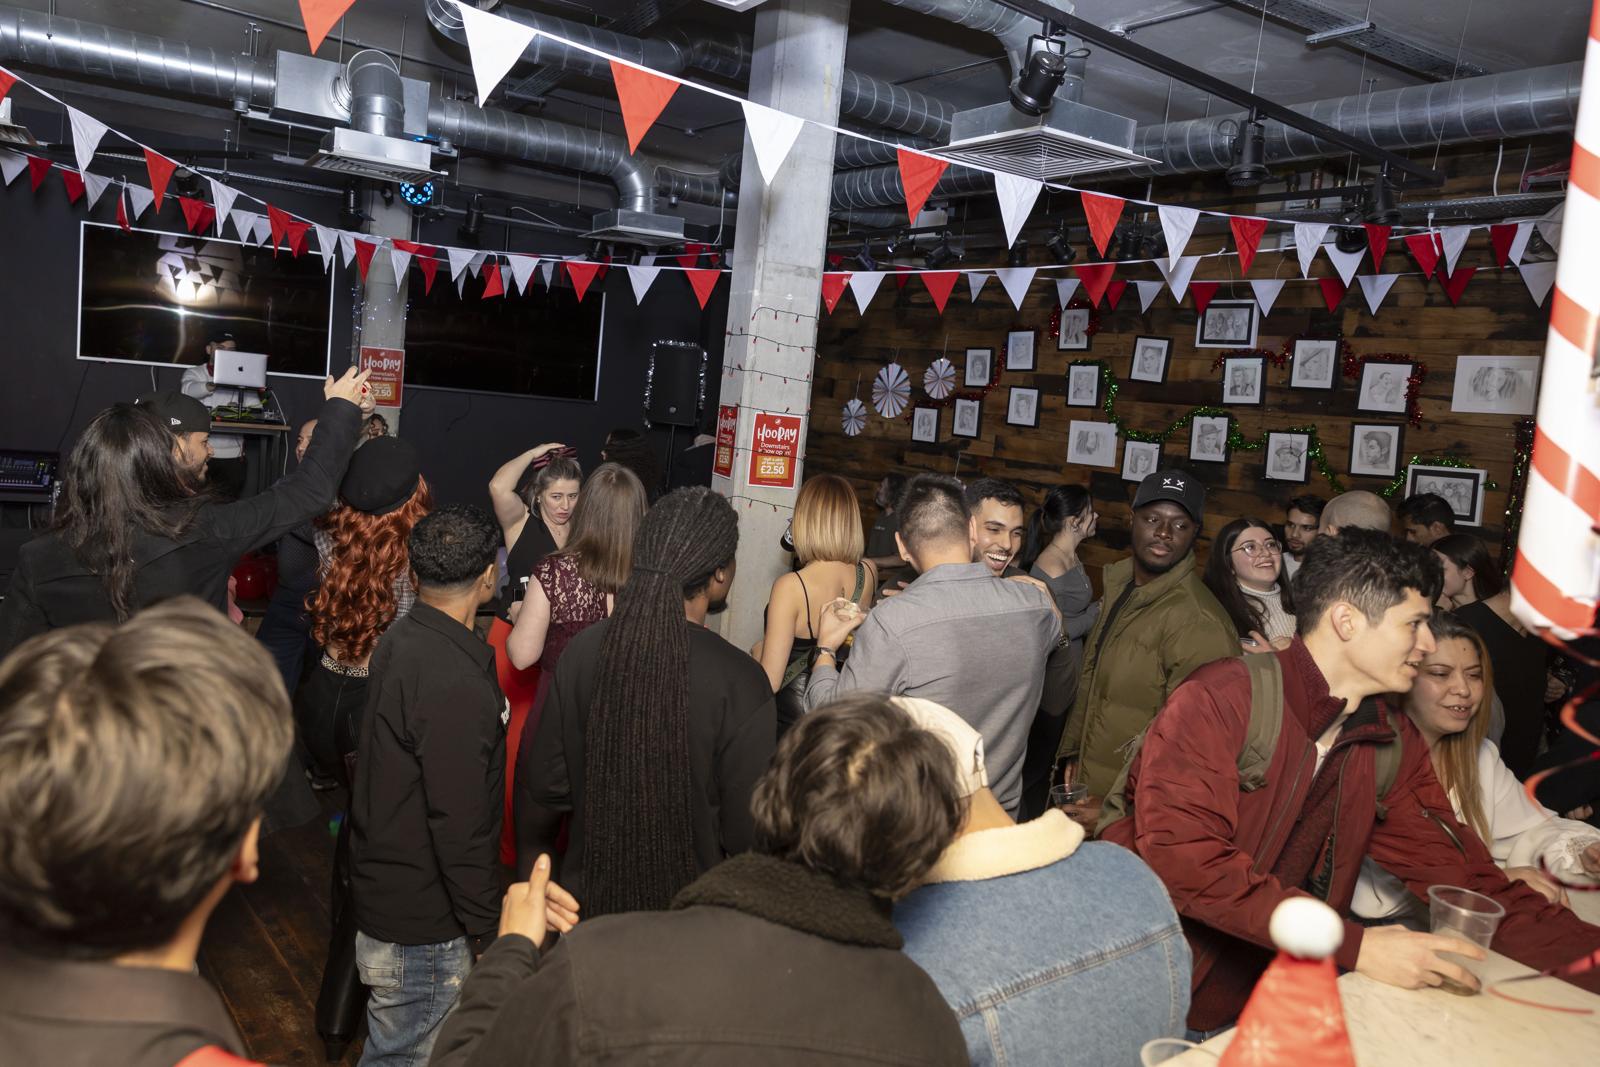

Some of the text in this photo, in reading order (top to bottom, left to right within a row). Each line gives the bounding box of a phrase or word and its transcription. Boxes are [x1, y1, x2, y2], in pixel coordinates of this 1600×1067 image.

[364, 355, 401, 372] HOORAY
[757, 423, 797, 443] HOORAY
[760, 442, 790, 450] Downstairs
[761, 465, 784, 475] £2.50
